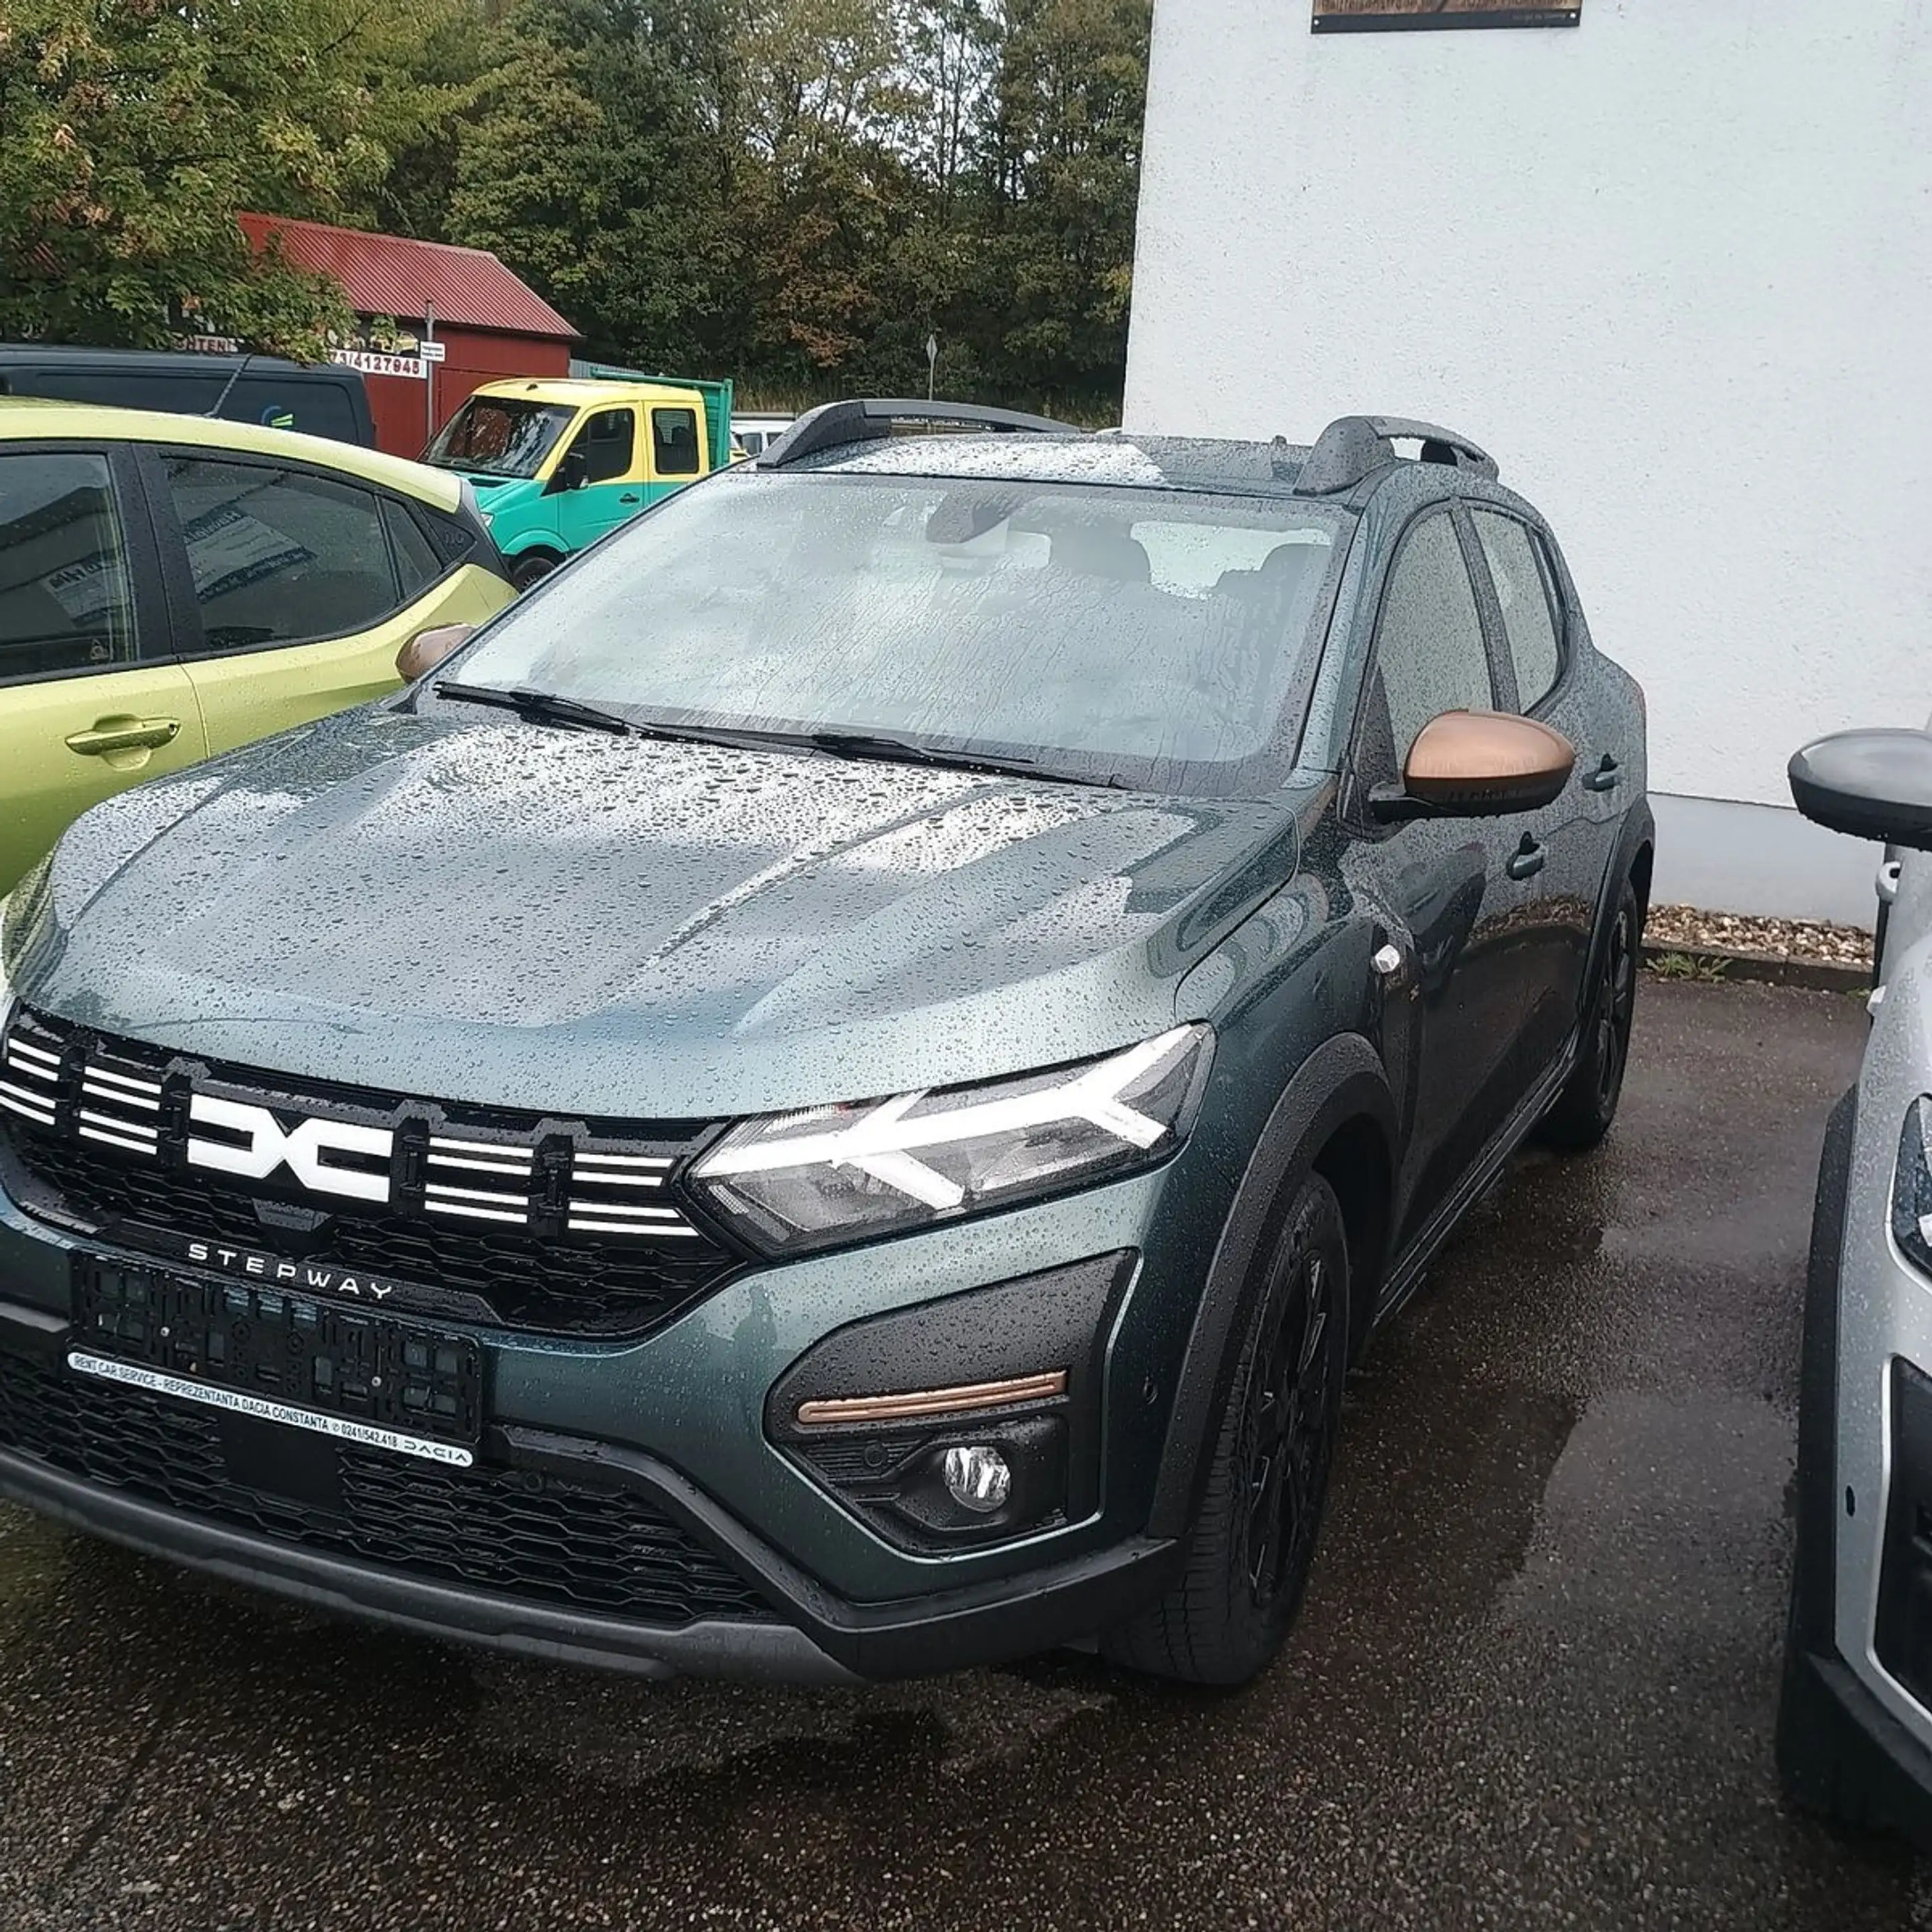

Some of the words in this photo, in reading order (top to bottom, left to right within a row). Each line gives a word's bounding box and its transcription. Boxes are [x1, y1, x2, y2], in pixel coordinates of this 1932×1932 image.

[188, 1243, 392, 1299] STEPWAY
[74, 1354, 97, 1371] RENT
[98, 1362, 116, 1375] CAR
[119, 1366, 157, 1388] SERVICE
[163, 1377, 239, 1409] REPREZENTANTA
[241, 1398, 271, 1416] DACIA
[272, 1406, 329, 1432] CONSTANTA
[404, 1440, 468, 1463] DACIA
